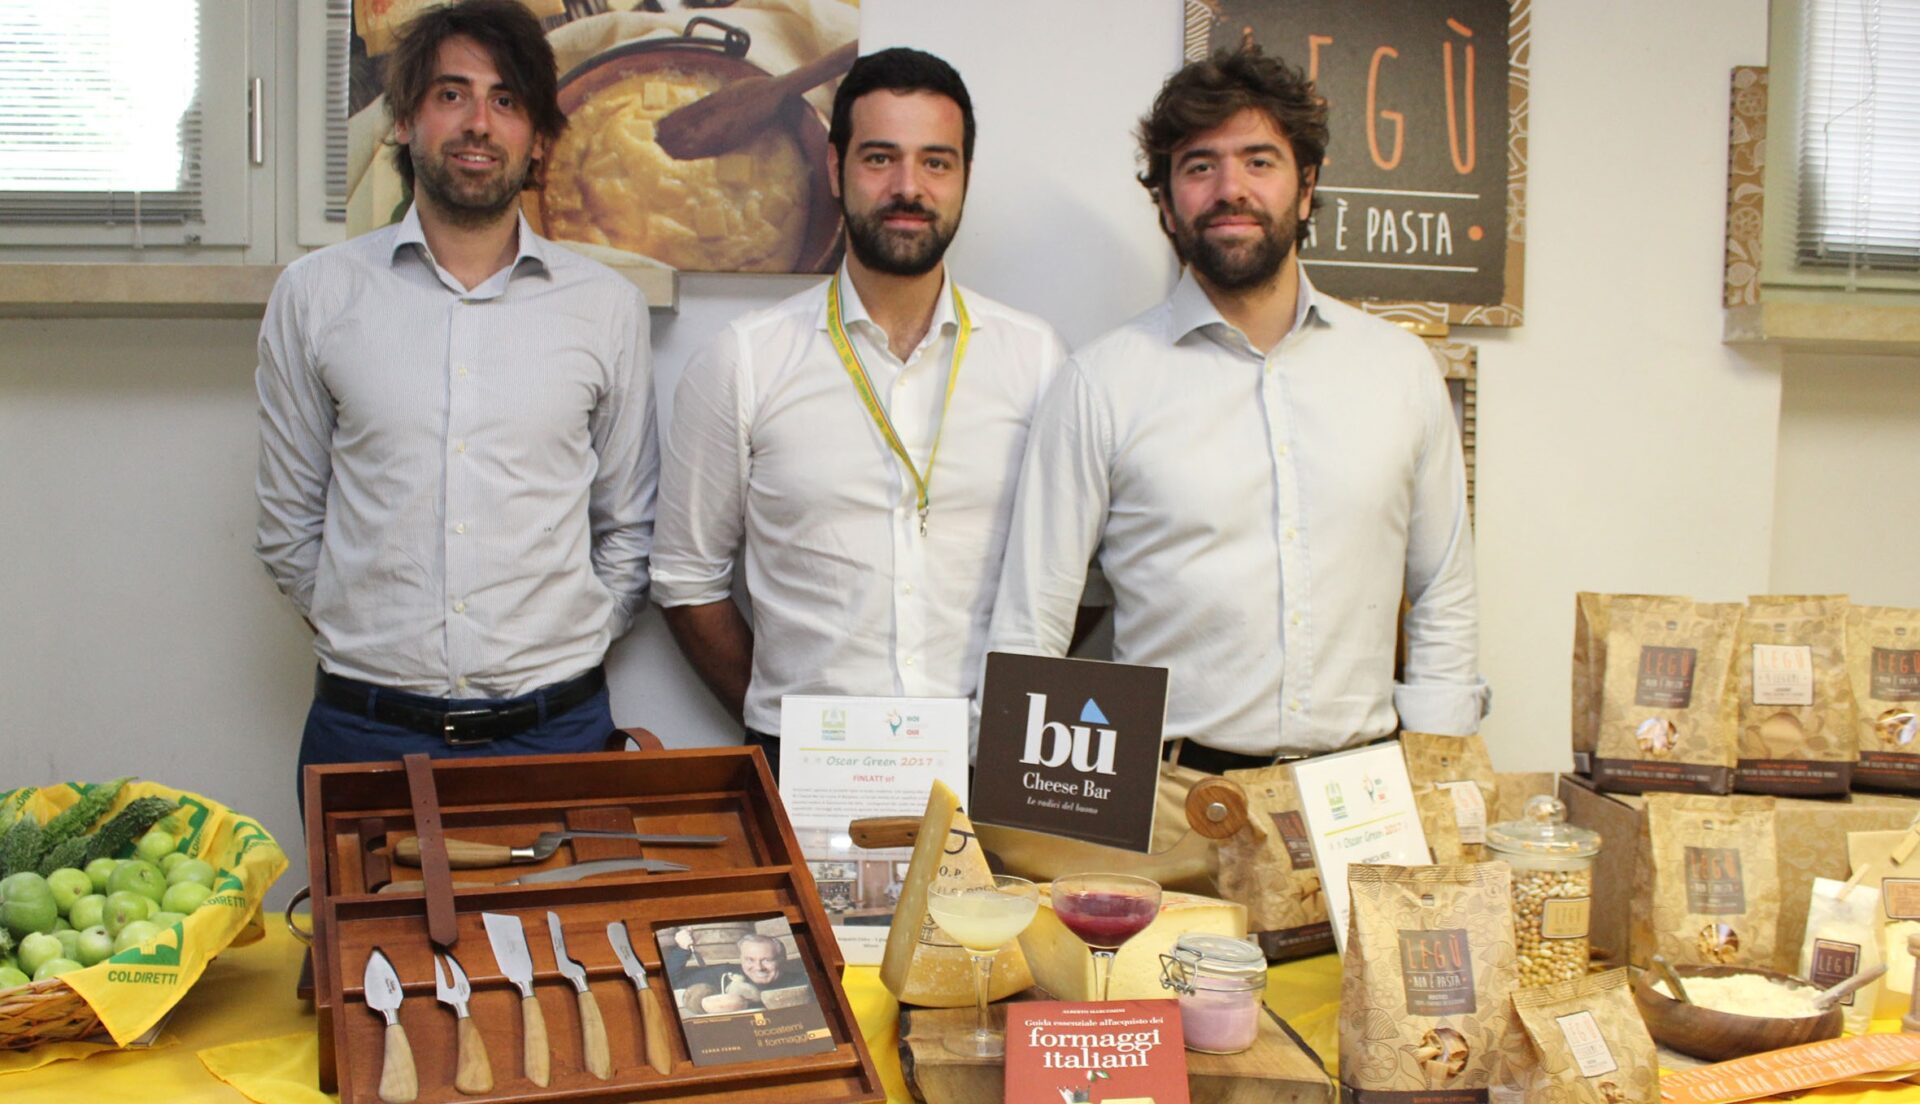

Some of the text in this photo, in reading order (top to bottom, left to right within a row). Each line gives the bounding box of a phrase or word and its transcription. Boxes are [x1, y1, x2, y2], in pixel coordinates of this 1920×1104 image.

[1243, 18, 1475, 175] GÙ
[1366, 206, 1453, 256] PASTA
[826, 755, 934, 767] Oscar Green 2017
[1022, 771, 1112, 800] Cheese Bar
[1061, 801, 1075, 812] del
[1405, 934, 1464, 970] LEGÙ
[107, 969, 178, 986] COLDIRETTI
[1435, 974, 1462, 989] PASTA
[753, 1022, 805, 1038] toccatemi
[1024, 1016, 1164, 1028] Guida essenziale all'acquisto dei
[1028, 1026, 1162, 1053] formaggi
[1042, 1047, 1149, 1069] italiani
